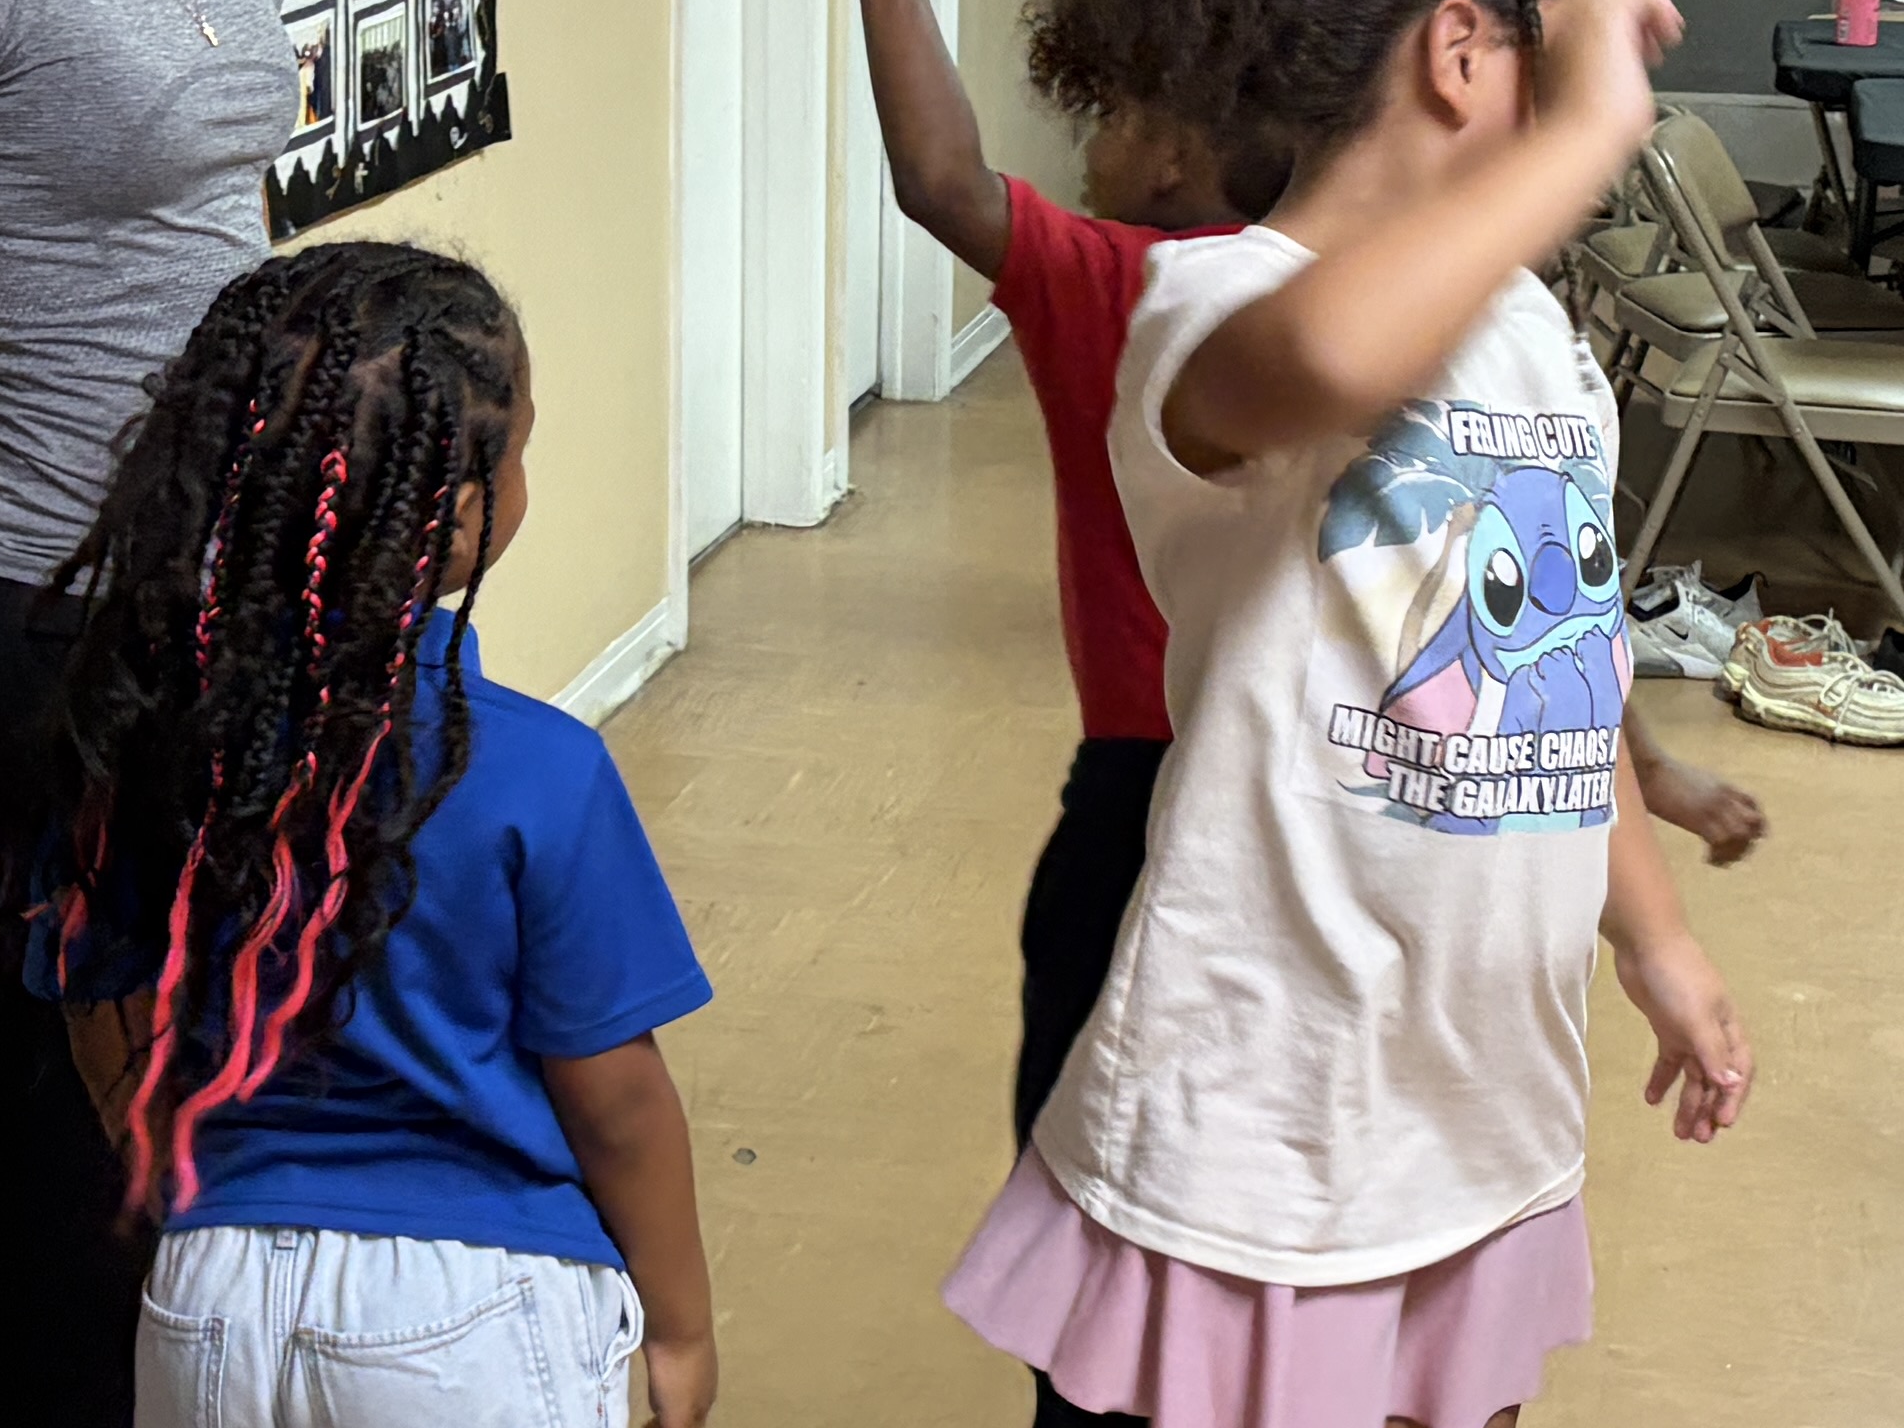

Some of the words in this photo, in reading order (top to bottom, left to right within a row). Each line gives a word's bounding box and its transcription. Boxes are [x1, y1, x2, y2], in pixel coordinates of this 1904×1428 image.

[1534, 413, 1599, 460] CUTE
[1328, 703, 1442, 768] MIGHT
[1444, 733, 1536, 775] CAUSE
[1538, 727, 1609, 772] CHAOS
[1387, 762, 1449, 813] THE
[1450, 773, 1557, 819] GALAXY
[1552, 770, 1612, 813] LATER
